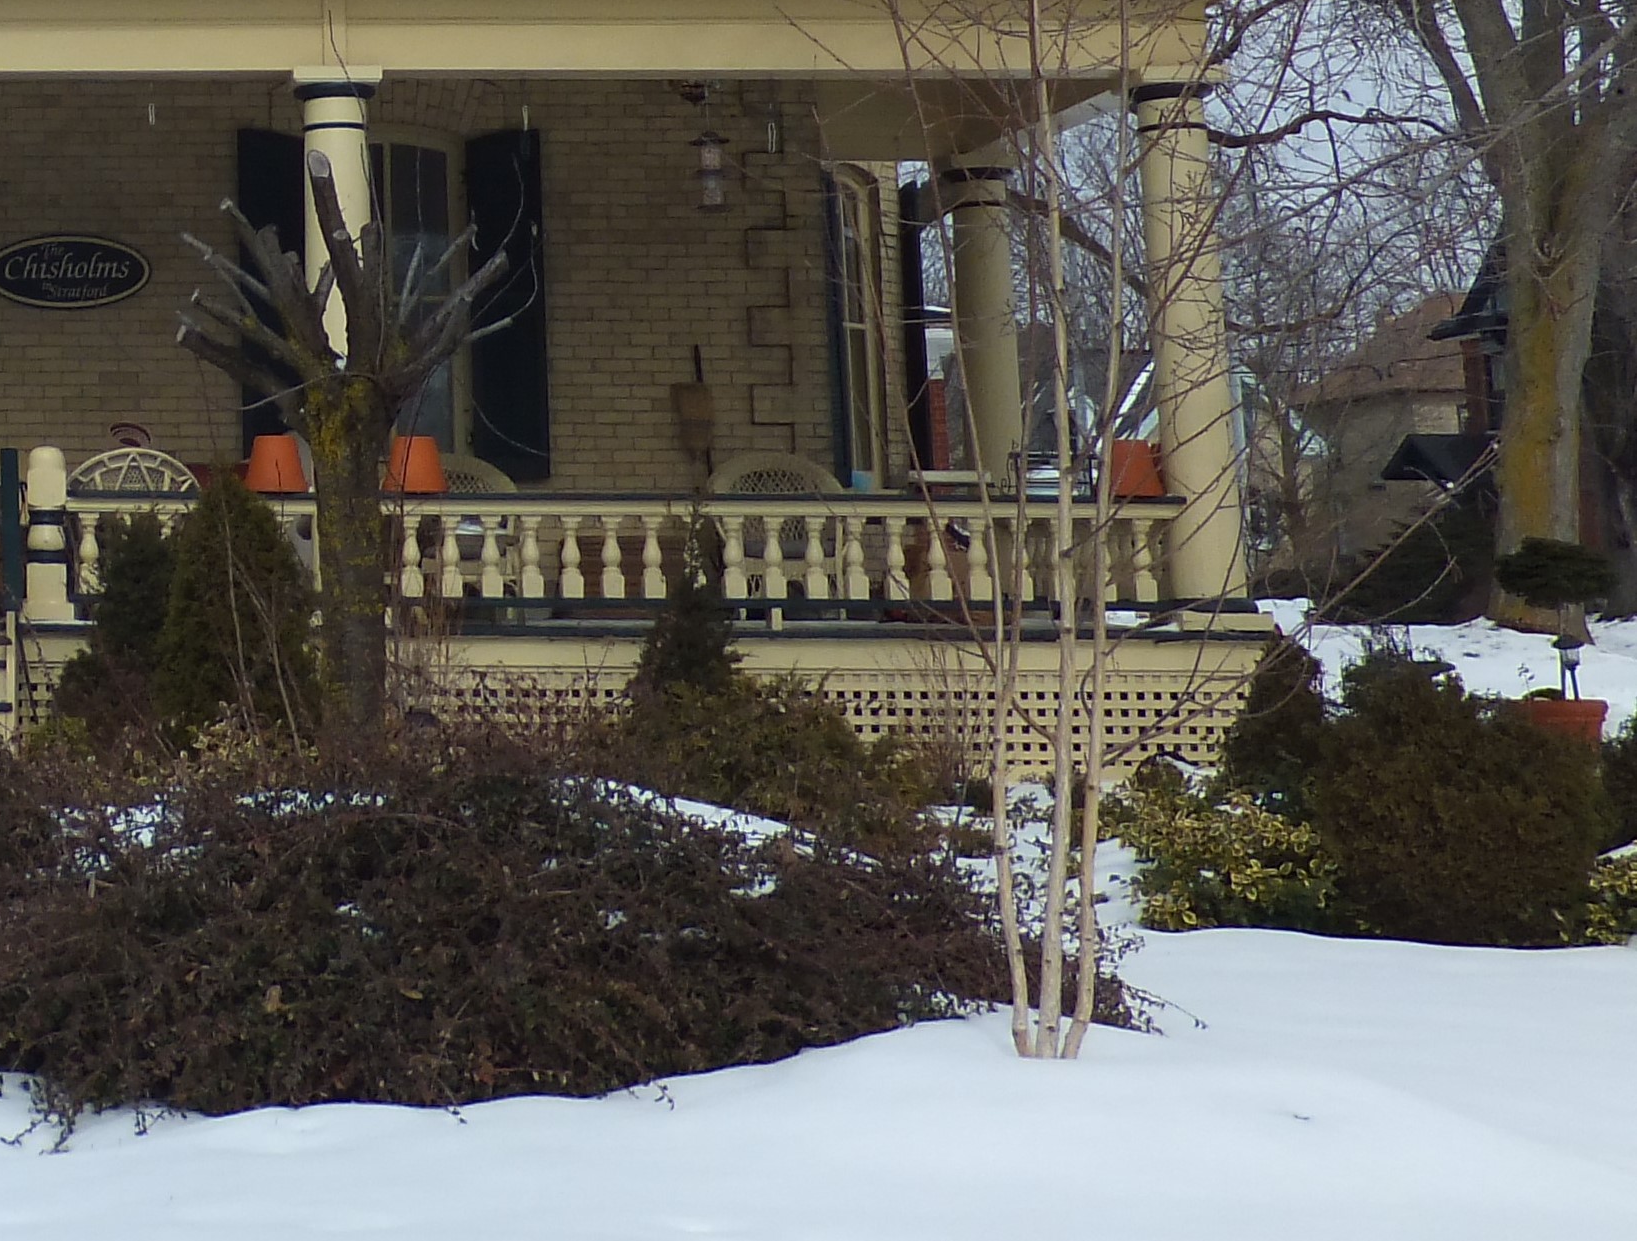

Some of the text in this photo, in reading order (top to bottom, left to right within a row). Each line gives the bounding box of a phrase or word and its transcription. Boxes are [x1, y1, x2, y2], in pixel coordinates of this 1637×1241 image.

[42, 243, 64, 258] The
[4, 252, 130, 280] Chisholms
[48, 282, 109, 301] Stratford
